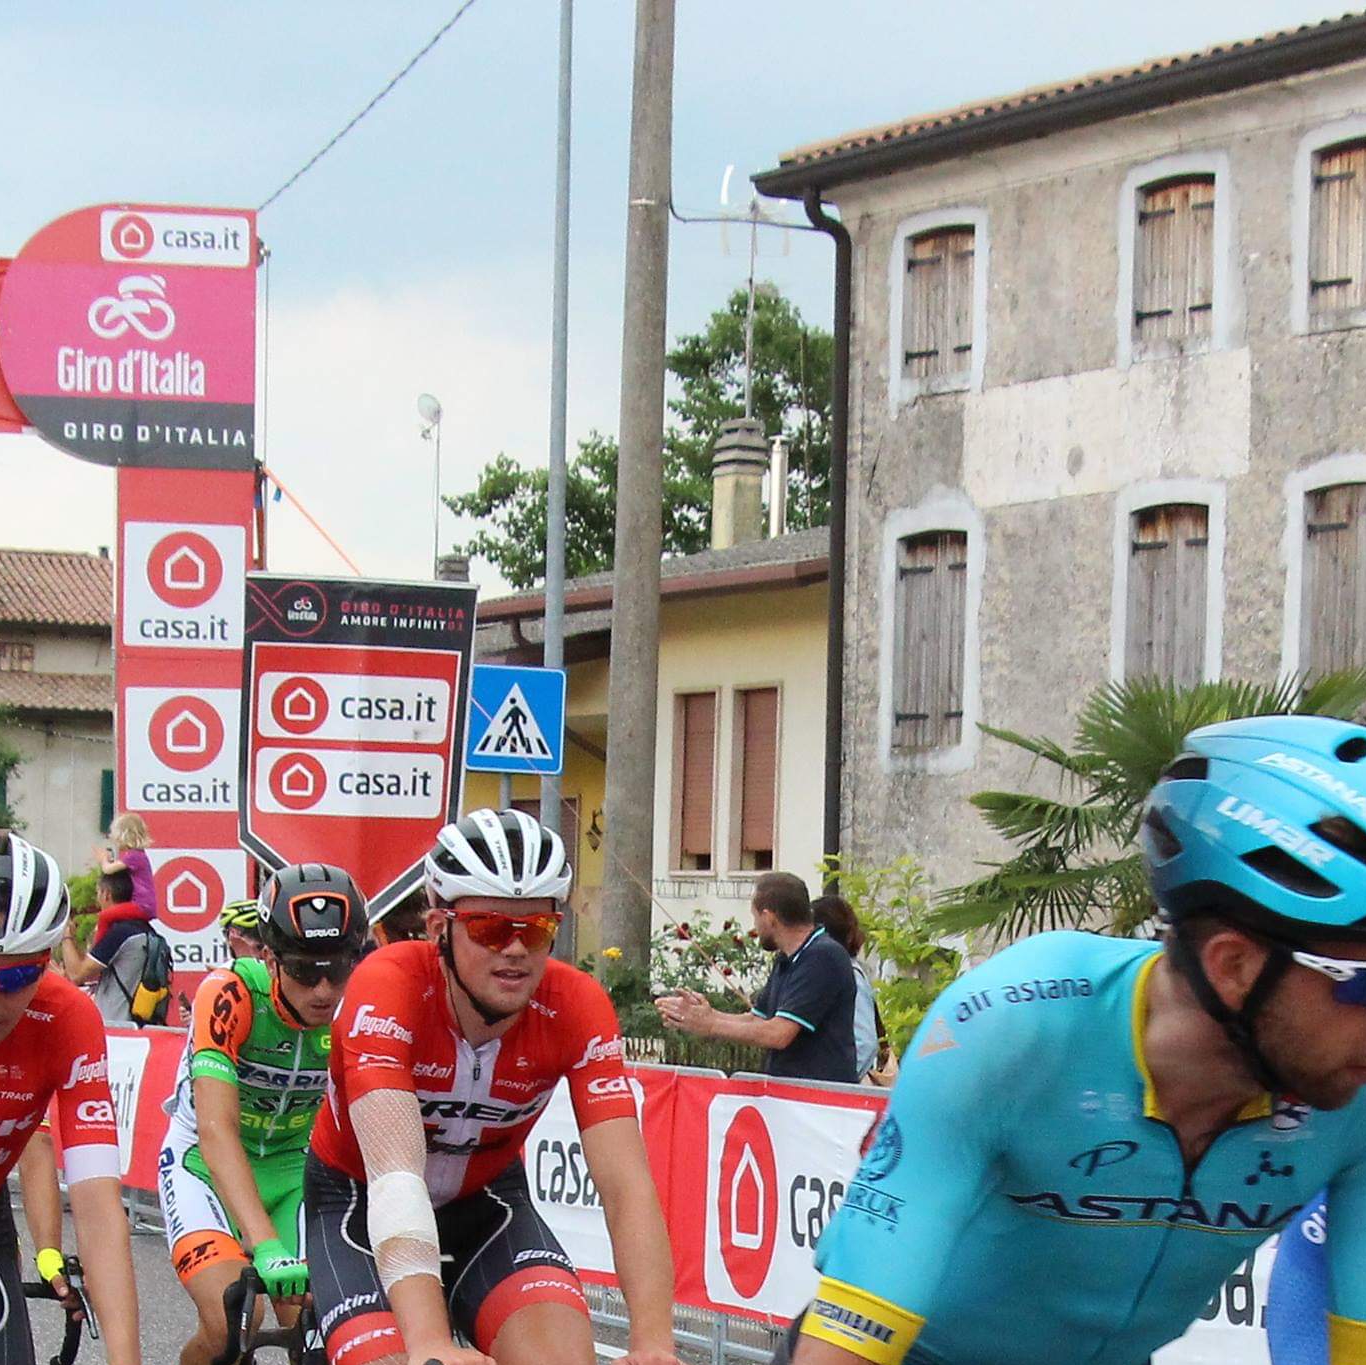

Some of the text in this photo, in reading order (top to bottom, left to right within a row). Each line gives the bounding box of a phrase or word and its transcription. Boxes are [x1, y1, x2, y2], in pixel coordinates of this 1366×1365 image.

[162, 226, 241, 252] casa.it
[57, 346, 206, 397] Giro d'Italia
[63, 421, 247, 447] GIRO D'ITALIA
[340, 600, 466, 619] GIRO D'ITALIA
[340, 615, 387, 627] AMORE
[139, 615, 229, 642] casa.it
[340, 692, 438, 723] casa.it
[141, 778, 231, 805] casa.it
[338, 768, 432, 798] casa.it
[528, 999, 559, 1019] REK
[953, 973, 1094, 1023] air astana
[209, 981, 243, 1046] CST
[75, 1098, 116, 1122] ca
[157, 1147, 186, 1237] BARDIANI
[847, 1186, 906, 1223] RUK
